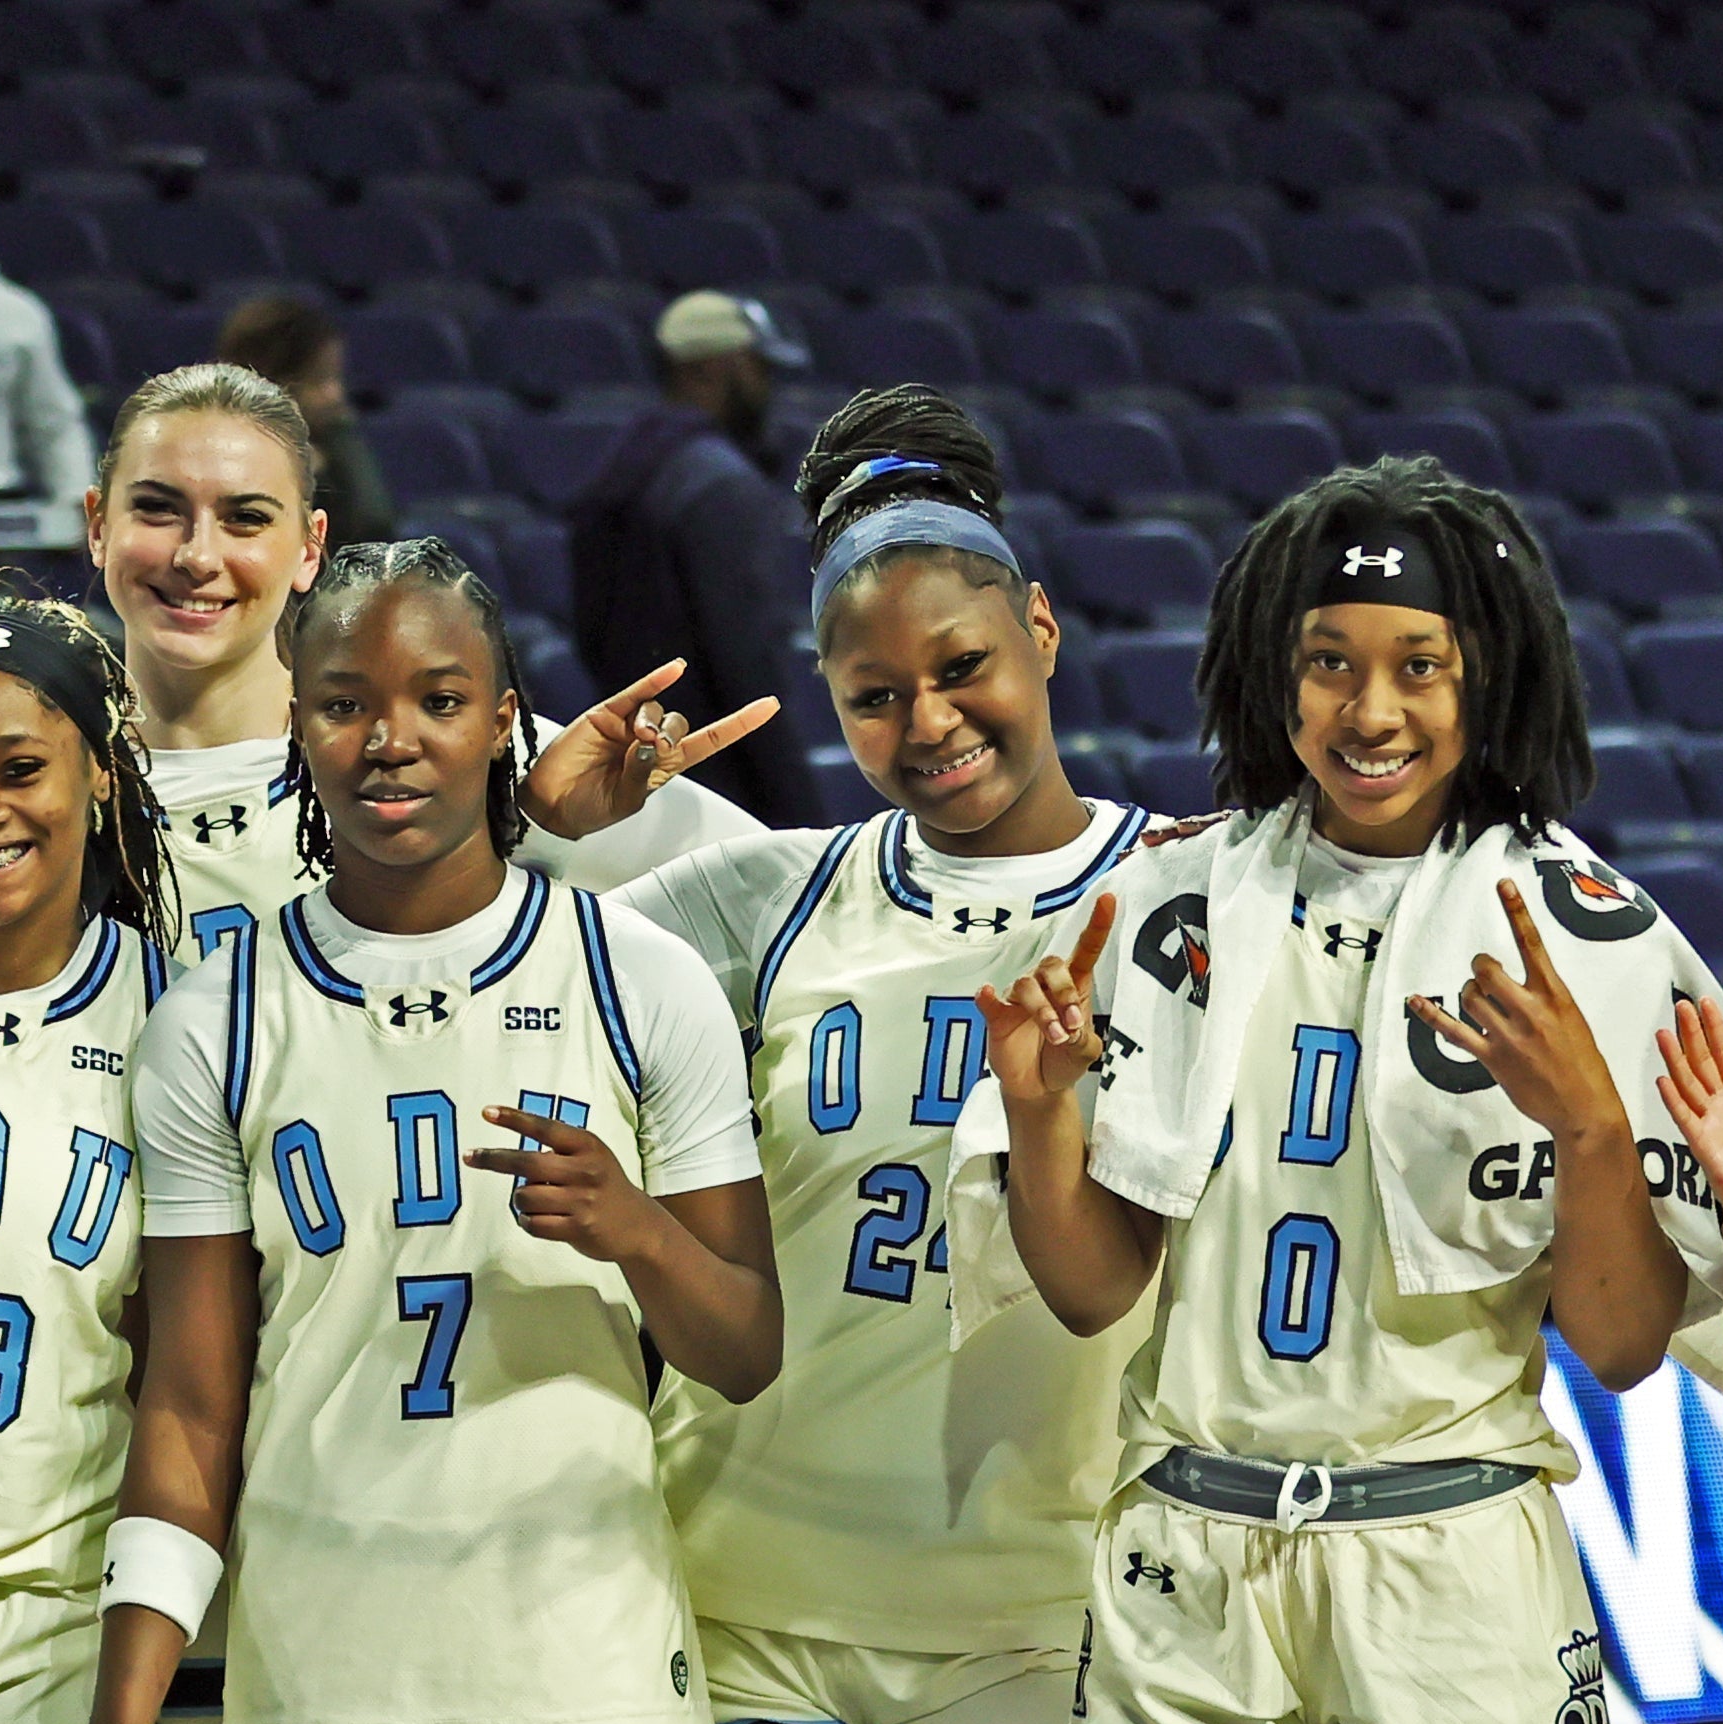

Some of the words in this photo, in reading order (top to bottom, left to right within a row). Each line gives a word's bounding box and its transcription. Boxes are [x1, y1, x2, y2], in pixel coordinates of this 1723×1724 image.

[71, 1045, 125, 1077] SBC
[504, 1006, 561, 1032] SBC
[843, 1163, 951, 1309] 2
[1257, 1211, 1341, 1363] 0
[397, 1273, 472, 1420] 7
